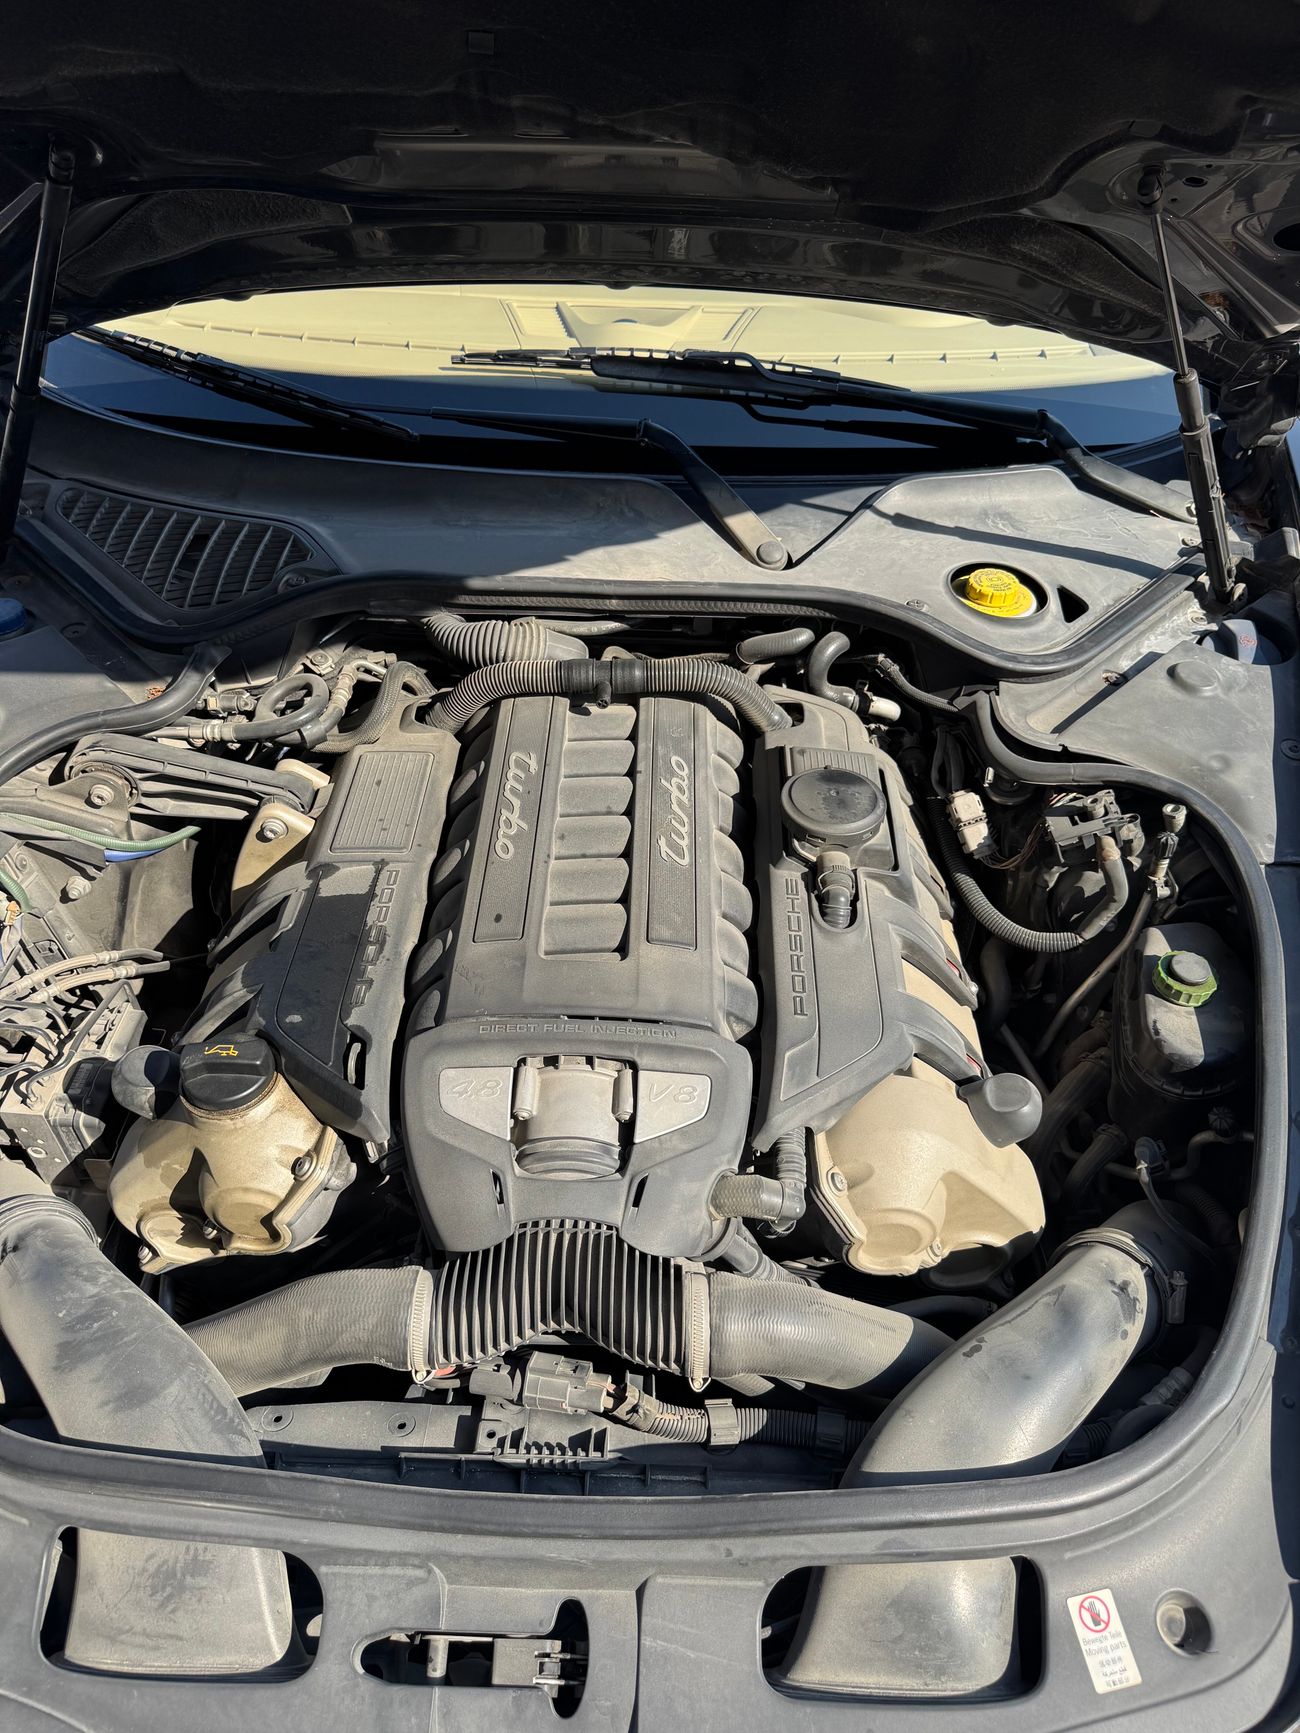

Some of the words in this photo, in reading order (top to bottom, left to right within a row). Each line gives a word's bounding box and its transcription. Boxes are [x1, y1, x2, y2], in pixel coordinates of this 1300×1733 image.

[494, 751, 539, 860] turbo
[657, 755, 690, 867] turbo
[351, 869, 400, 1007] PORSCHE
[785, 878, 809, 1017] PORSCHE
[479, 1024, 538, 1034] DIRECT
[544, 1024, 585, 1033] FUEL
[591, 1025, 677, 1039] INJECTION
[1085, 1645, 1109, 1656] Moving
[1110, 1641, 1127, 1652] parts
